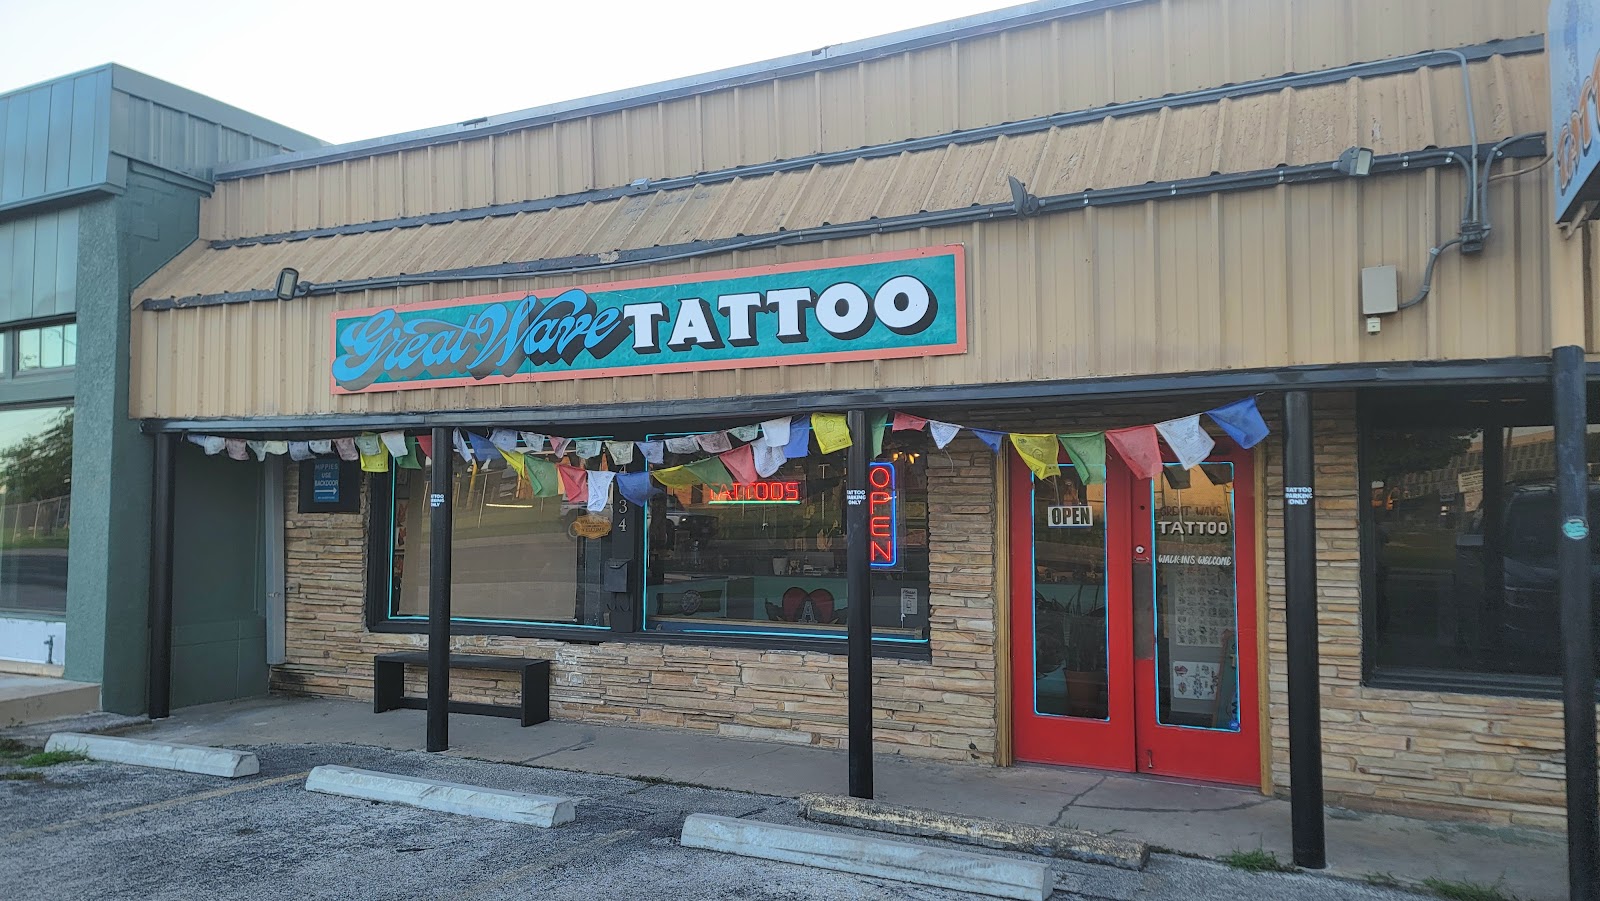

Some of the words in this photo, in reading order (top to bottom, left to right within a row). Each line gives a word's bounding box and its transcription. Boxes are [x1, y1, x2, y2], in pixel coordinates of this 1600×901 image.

[332, 308, 479, 383] Great
[466, 288, 622, 370] Wave
[623, 274, 932, 350] TATTOO
[869, 466, 891, 562] OPEN
[1051, 507, 1091, 525] OPEN
[1196, 505, 1223, 517] WAVE
[1157, 521, 1228, 535] TATTOO
[1158, 555, 1196, 565] WALK-INS
[1198, 555, 1232, 566] WELCOME
